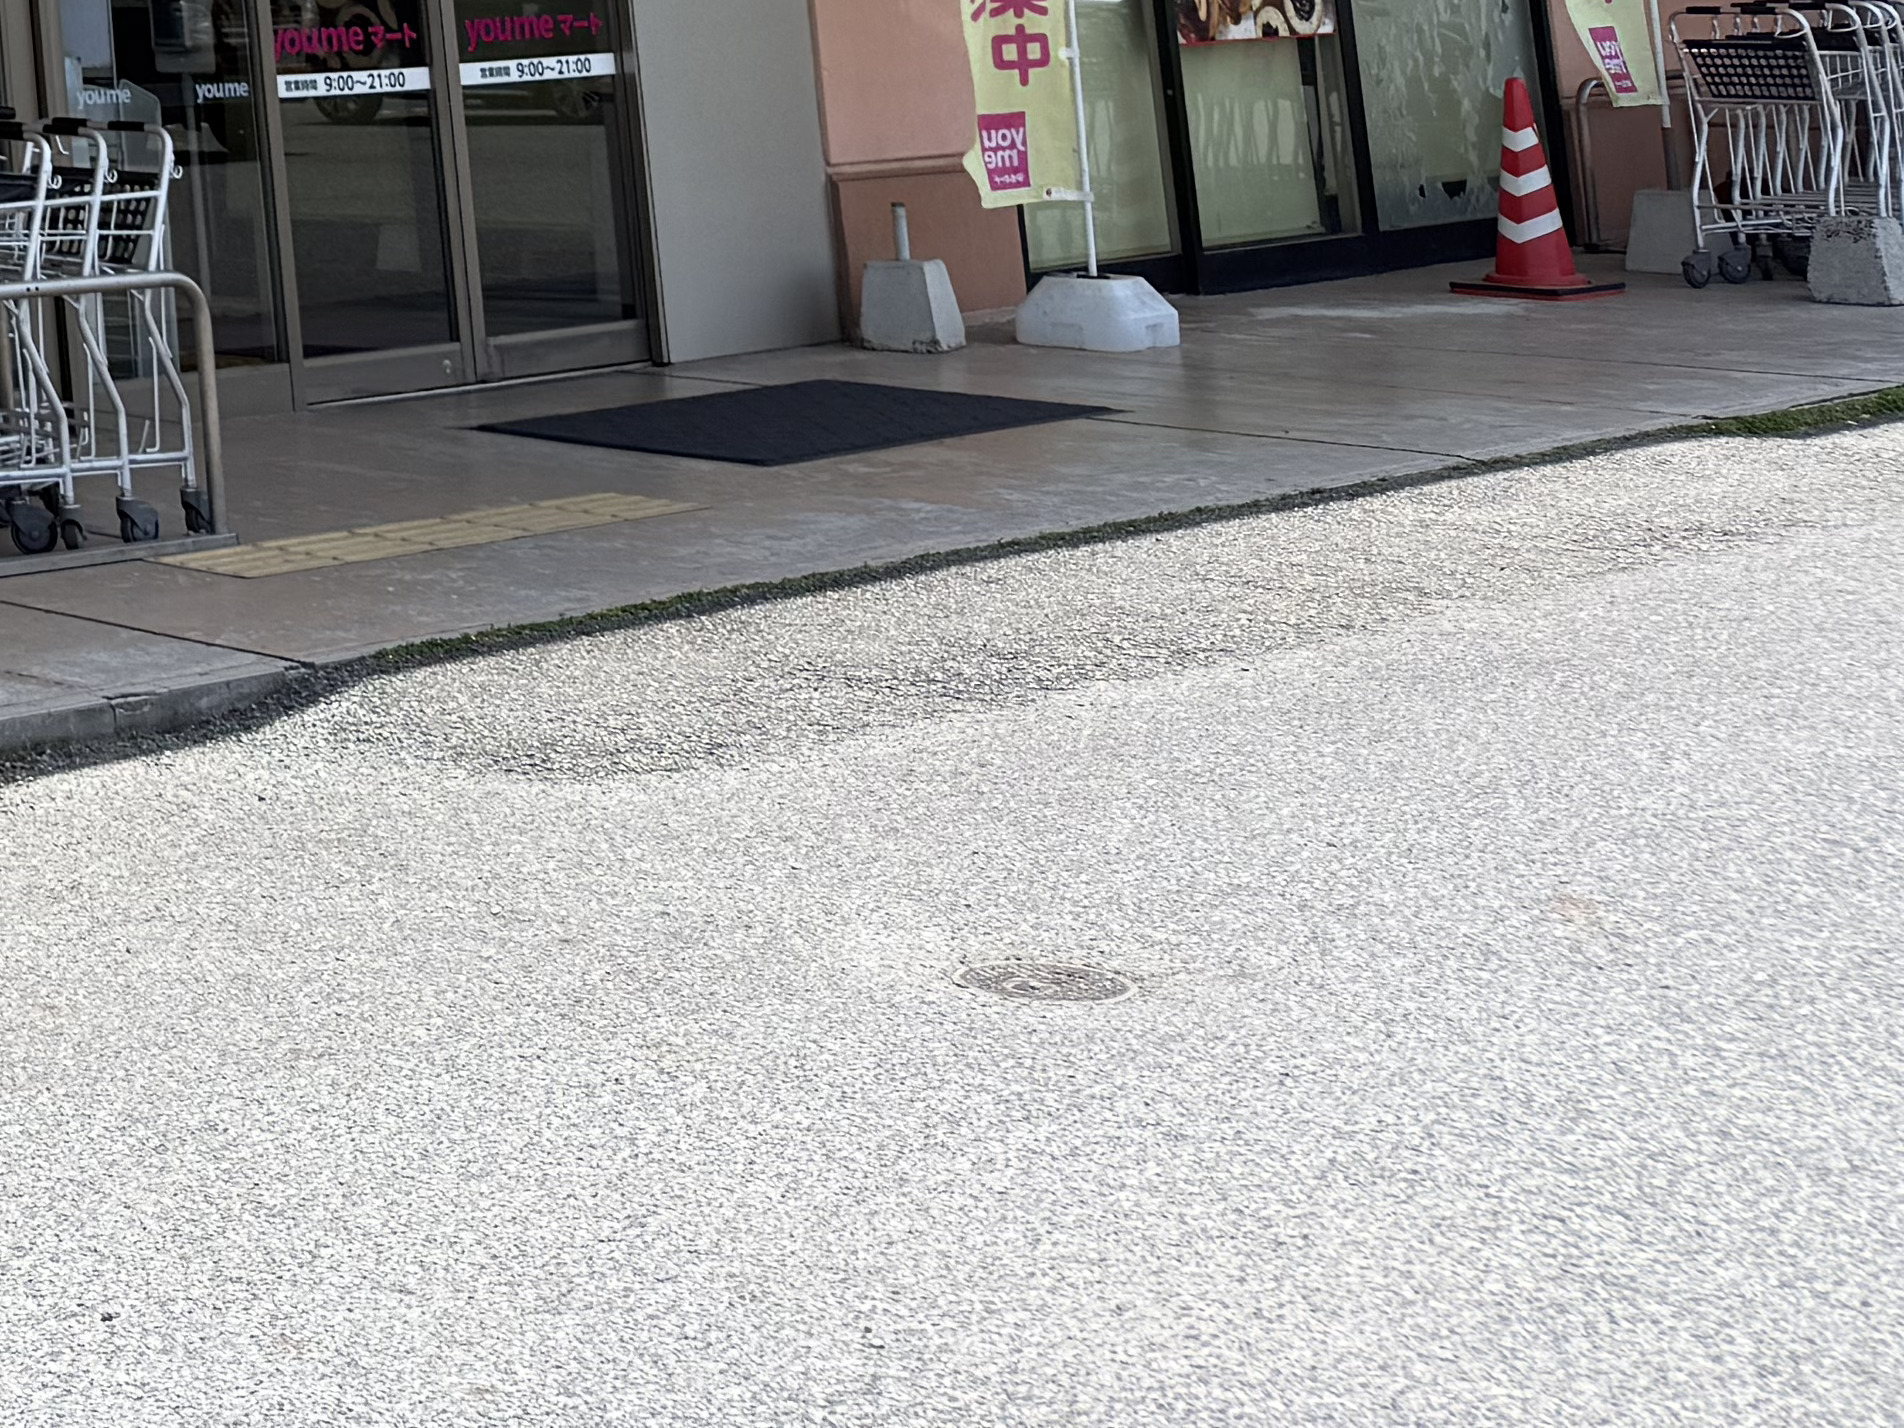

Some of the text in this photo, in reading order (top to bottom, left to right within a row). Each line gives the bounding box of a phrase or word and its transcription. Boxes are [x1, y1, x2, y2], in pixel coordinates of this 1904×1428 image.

[274, 22, 418, 62] youme マート
[464, 11, 604, 52] youme マート
[76, 88, 132, 110] youme
[195, 78, 249, 102] youme
